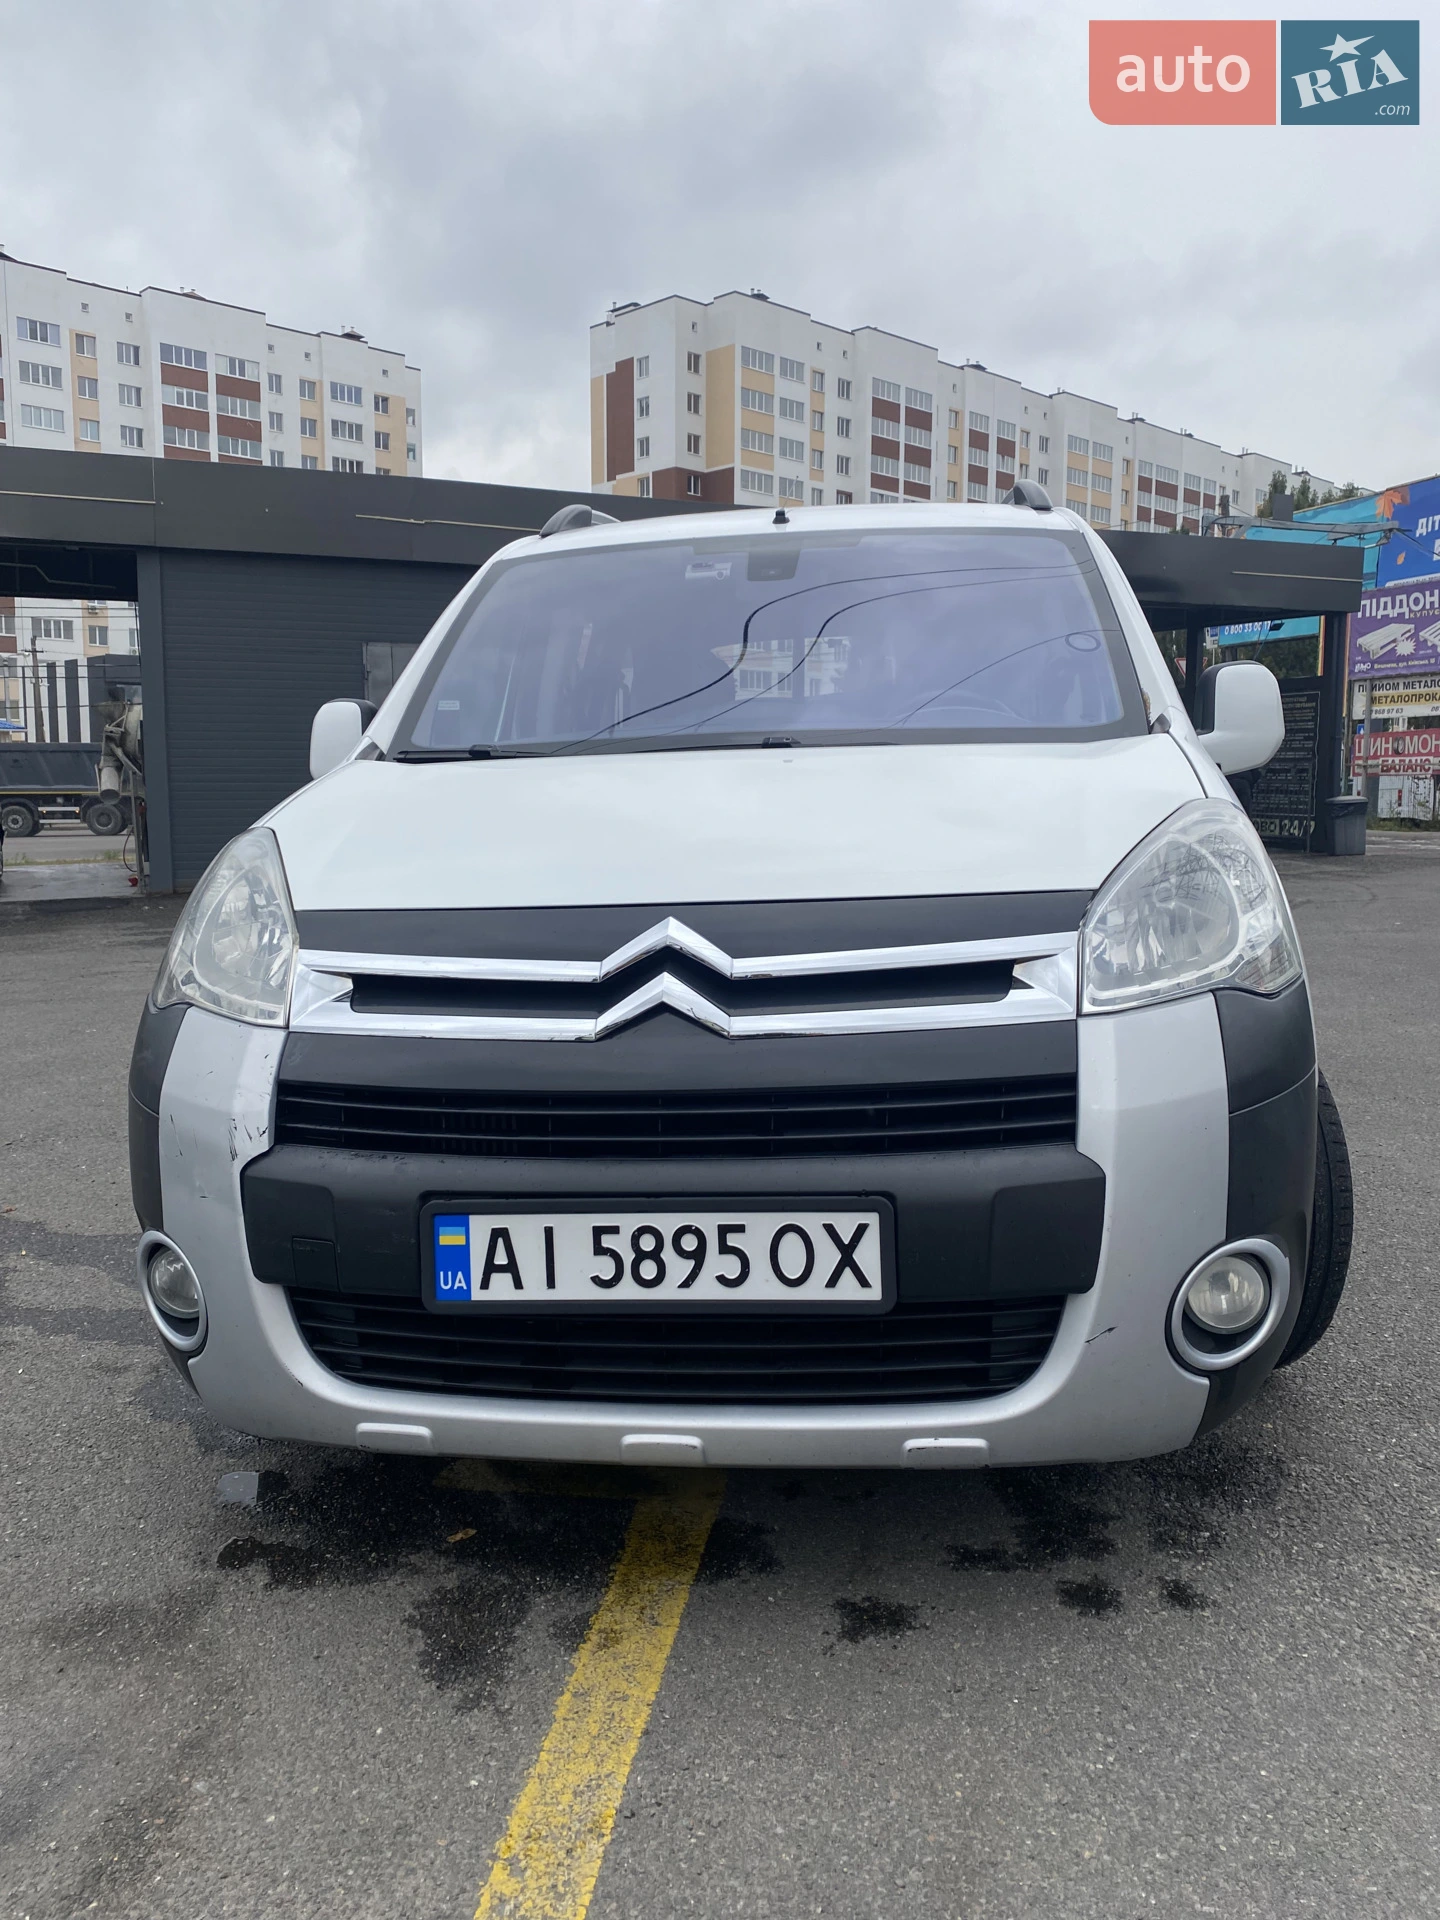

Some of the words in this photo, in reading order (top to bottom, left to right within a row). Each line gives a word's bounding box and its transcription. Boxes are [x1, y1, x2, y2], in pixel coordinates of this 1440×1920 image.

[1380, 757, 1431, 773] БАЛАНС
[479, 1226, 556, 1291] AI
[589, 1223, 751, 1289] 5895
[768, 1222, 873, 1289] OX
[439, 1271, 467, 1291] UA
